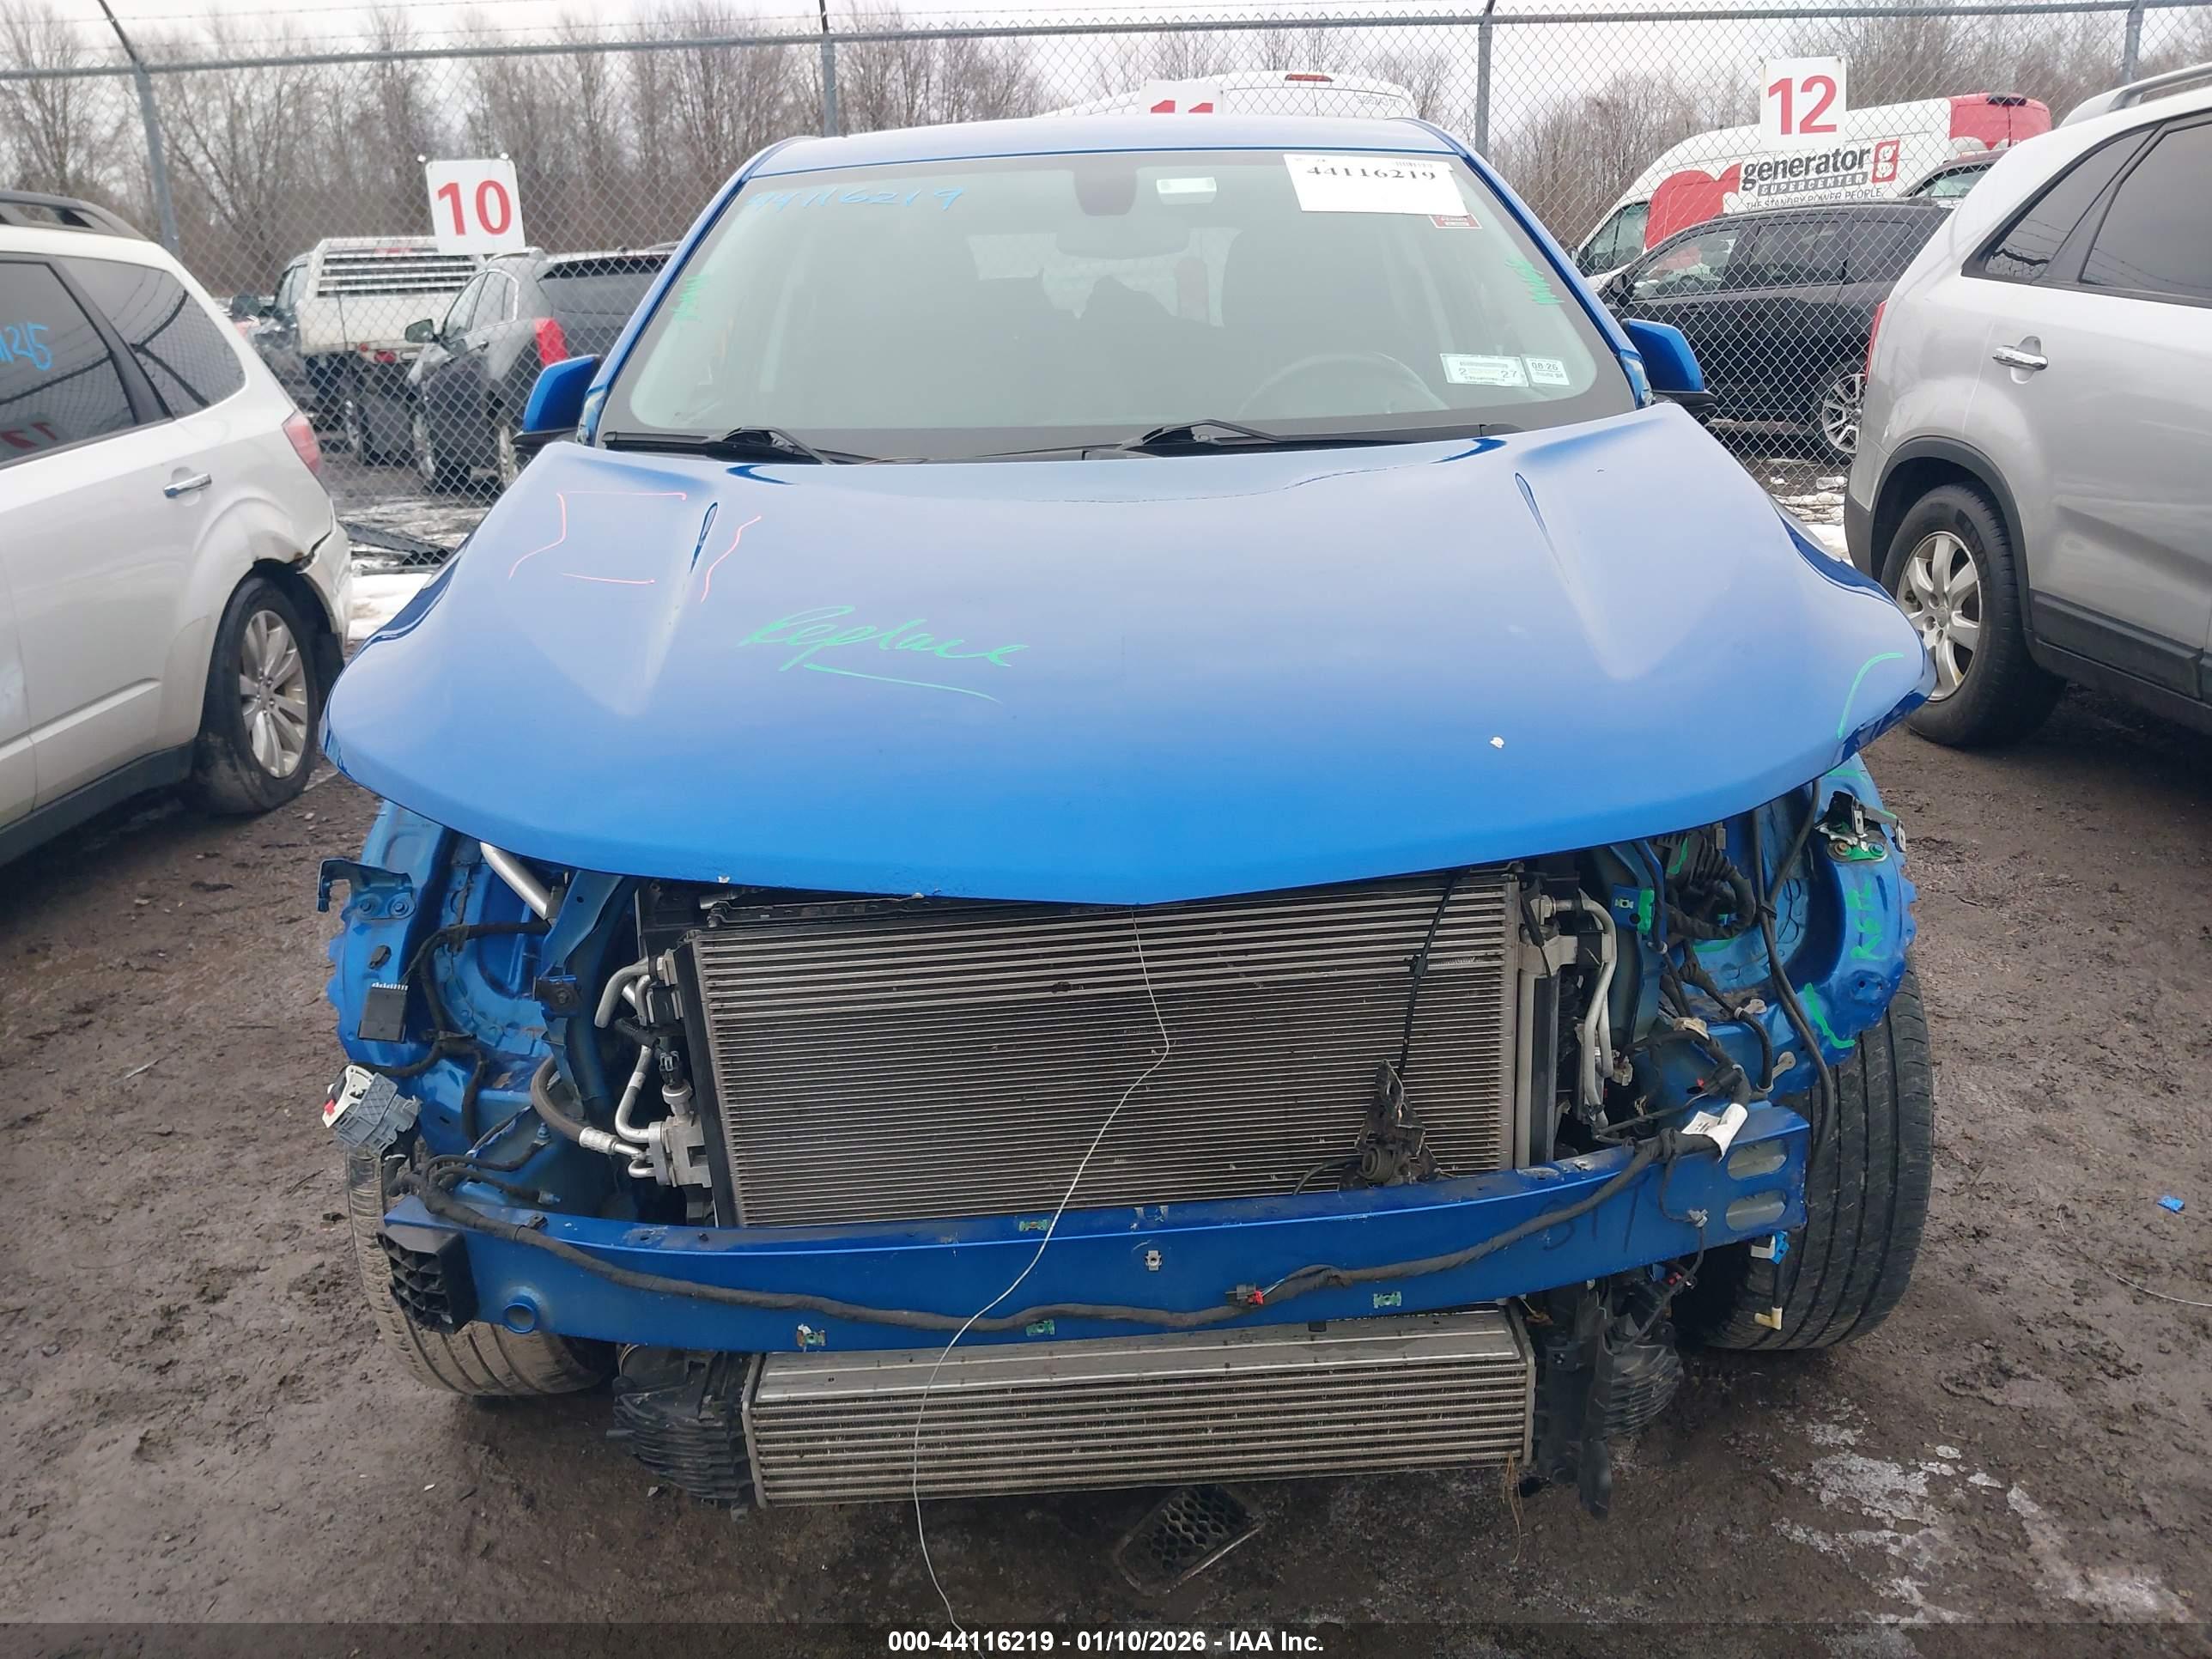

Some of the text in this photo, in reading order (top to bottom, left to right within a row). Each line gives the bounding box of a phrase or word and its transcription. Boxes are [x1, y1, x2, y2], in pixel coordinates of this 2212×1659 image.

[1768, 75, 1837, 135] 12
[1307, 167, 1437, 179] 44116219
[1741, 147, 1870, 191] generator
[1760, 173, 1864, 196] SUPERCENTER
[438, 179, 512, 235] 10
